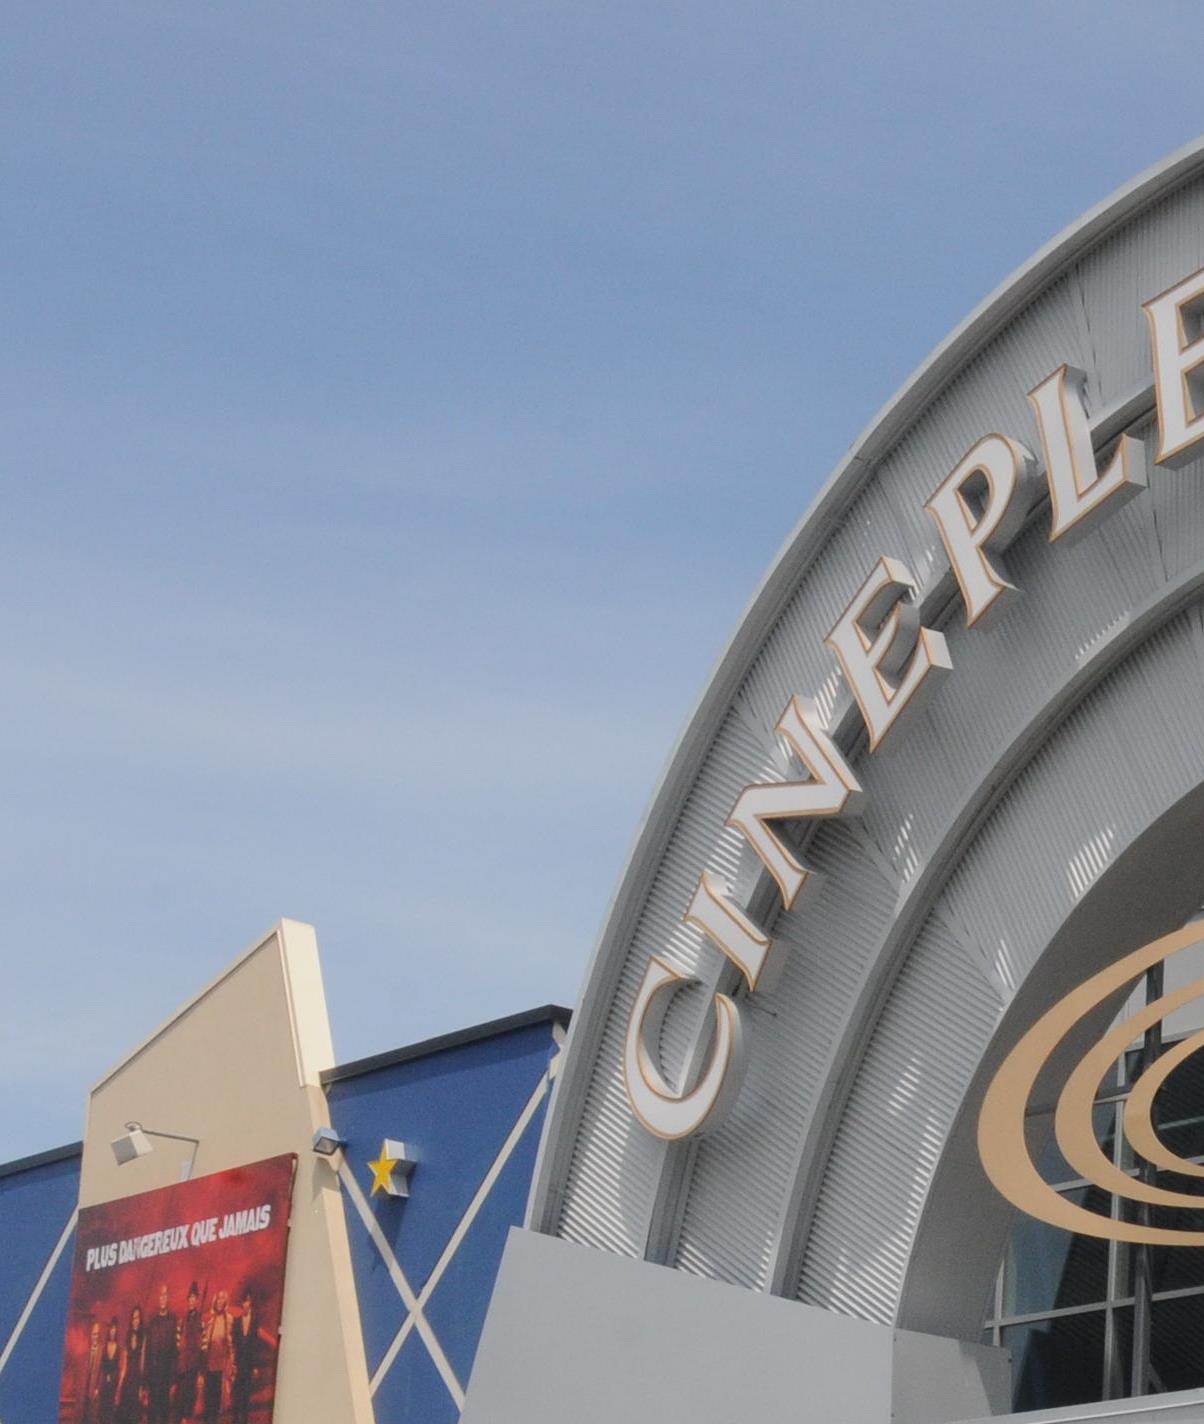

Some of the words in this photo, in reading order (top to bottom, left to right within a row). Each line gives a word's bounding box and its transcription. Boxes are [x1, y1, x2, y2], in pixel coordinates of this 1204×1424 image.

[86, 1243, 118, 1272] PLUS
[118, 1224, 190, 1264] DANGEREUX
[190, 1217, 218, 1248] QUE
[219, 1204, 272, 1239] JAMAIS
